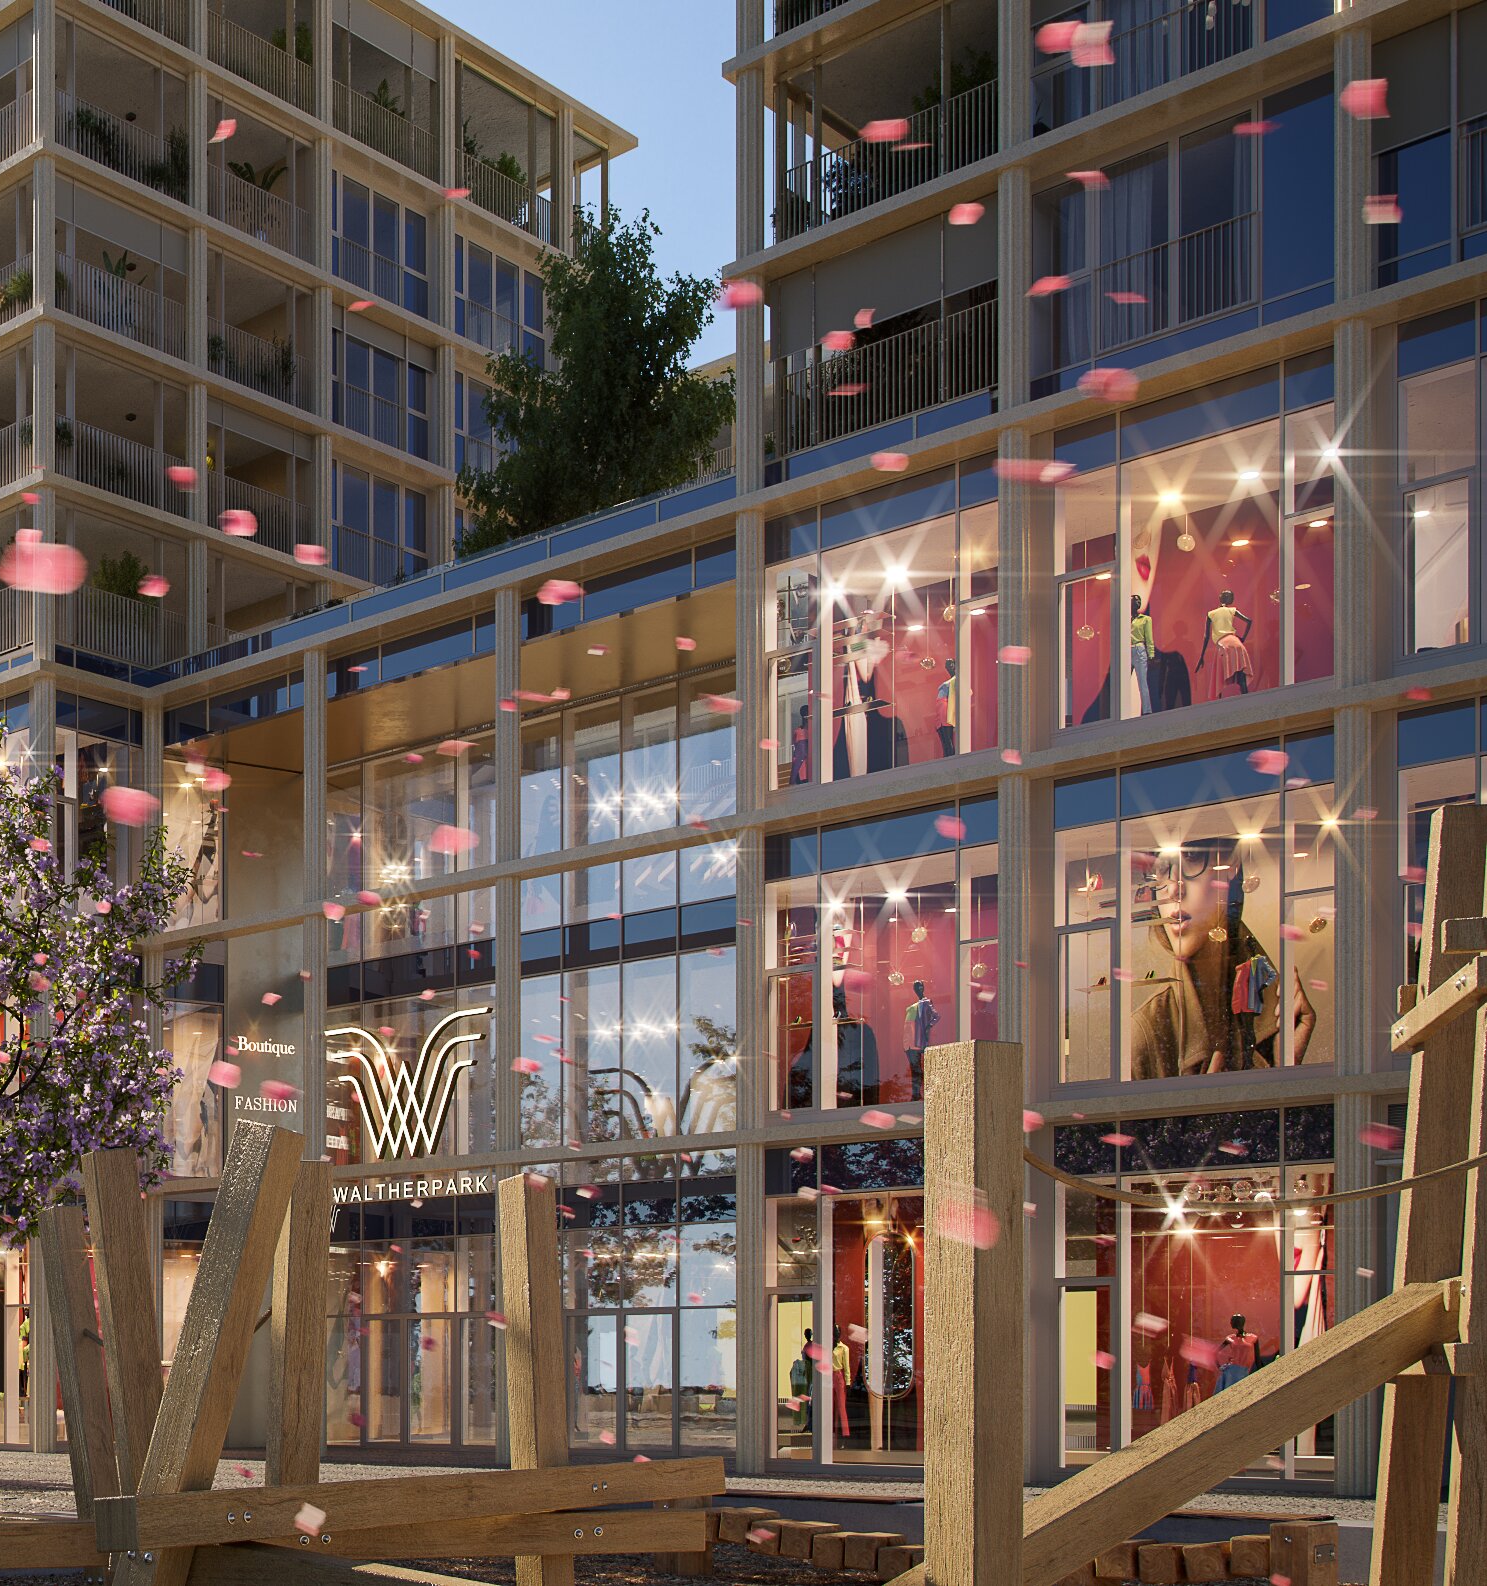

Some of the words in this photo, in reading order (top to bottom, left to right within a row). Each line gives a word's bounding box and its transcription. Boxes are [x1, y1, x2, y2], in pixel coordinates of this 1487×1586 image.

[237, 1035, 296, 1058] Boutique
[234, 1095, 298, 1114] FASHION
[333, 1175, 489, 1204] WALTHERPARK
